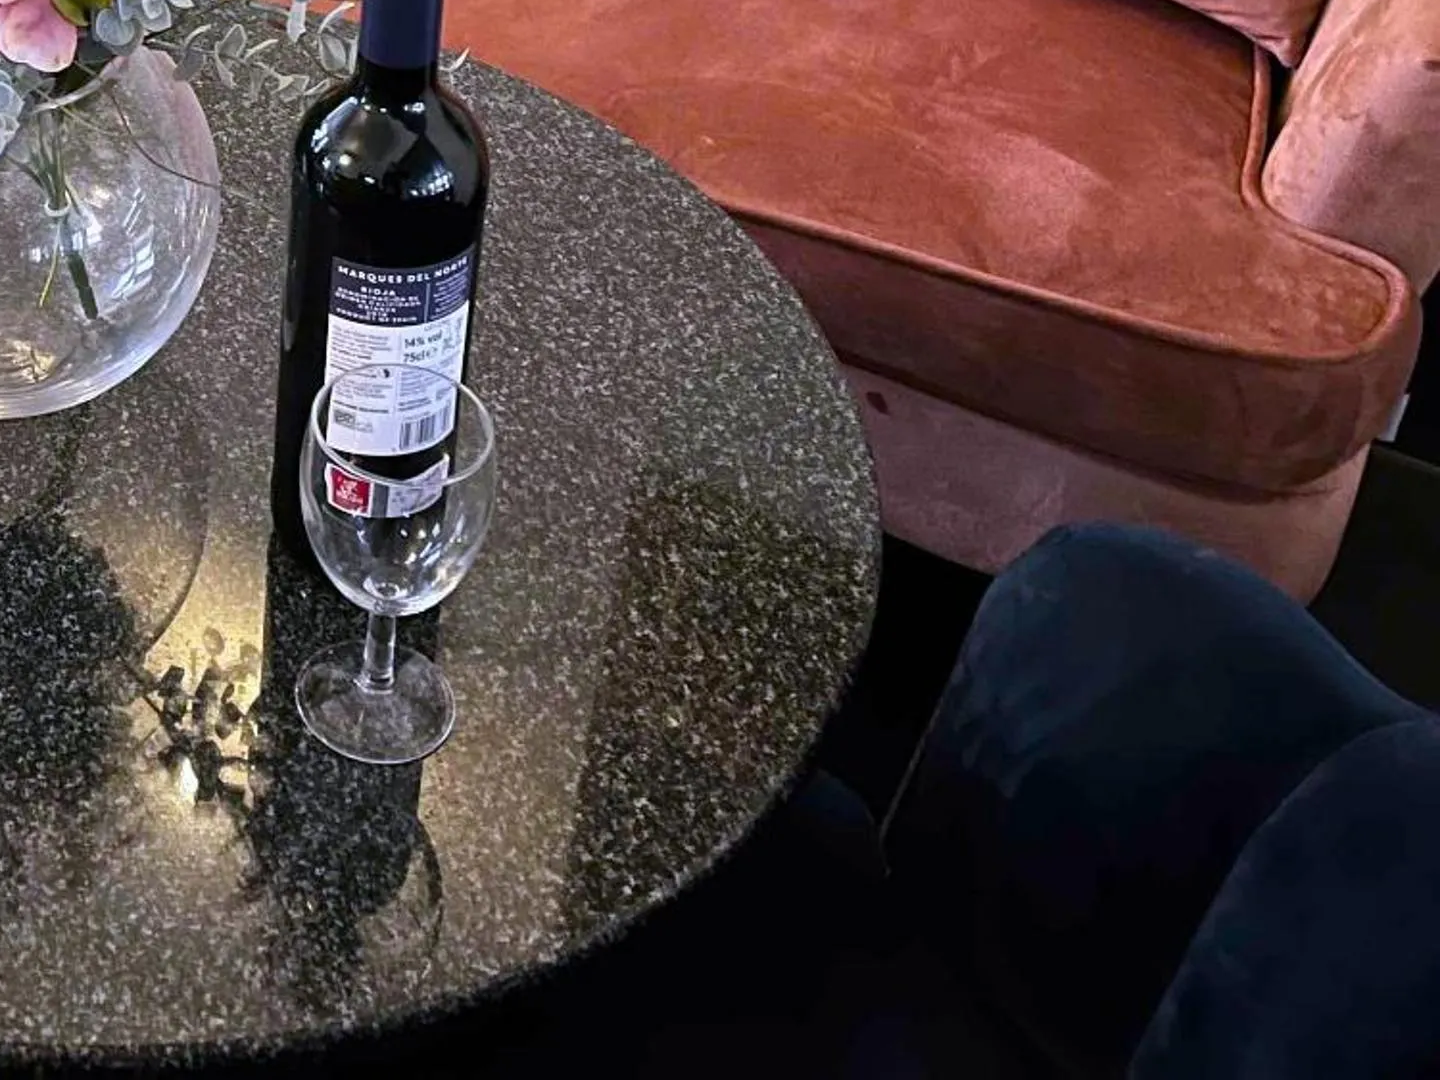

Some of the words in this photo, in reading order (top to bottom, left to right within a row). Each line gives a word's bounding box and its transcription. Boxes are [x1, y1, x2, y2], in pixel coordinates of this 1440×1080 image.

[338, 265, 402, 284] MARQUES
[406, 272, 430, 283] DEL
[360, 286, 396, 296] RIOJA
